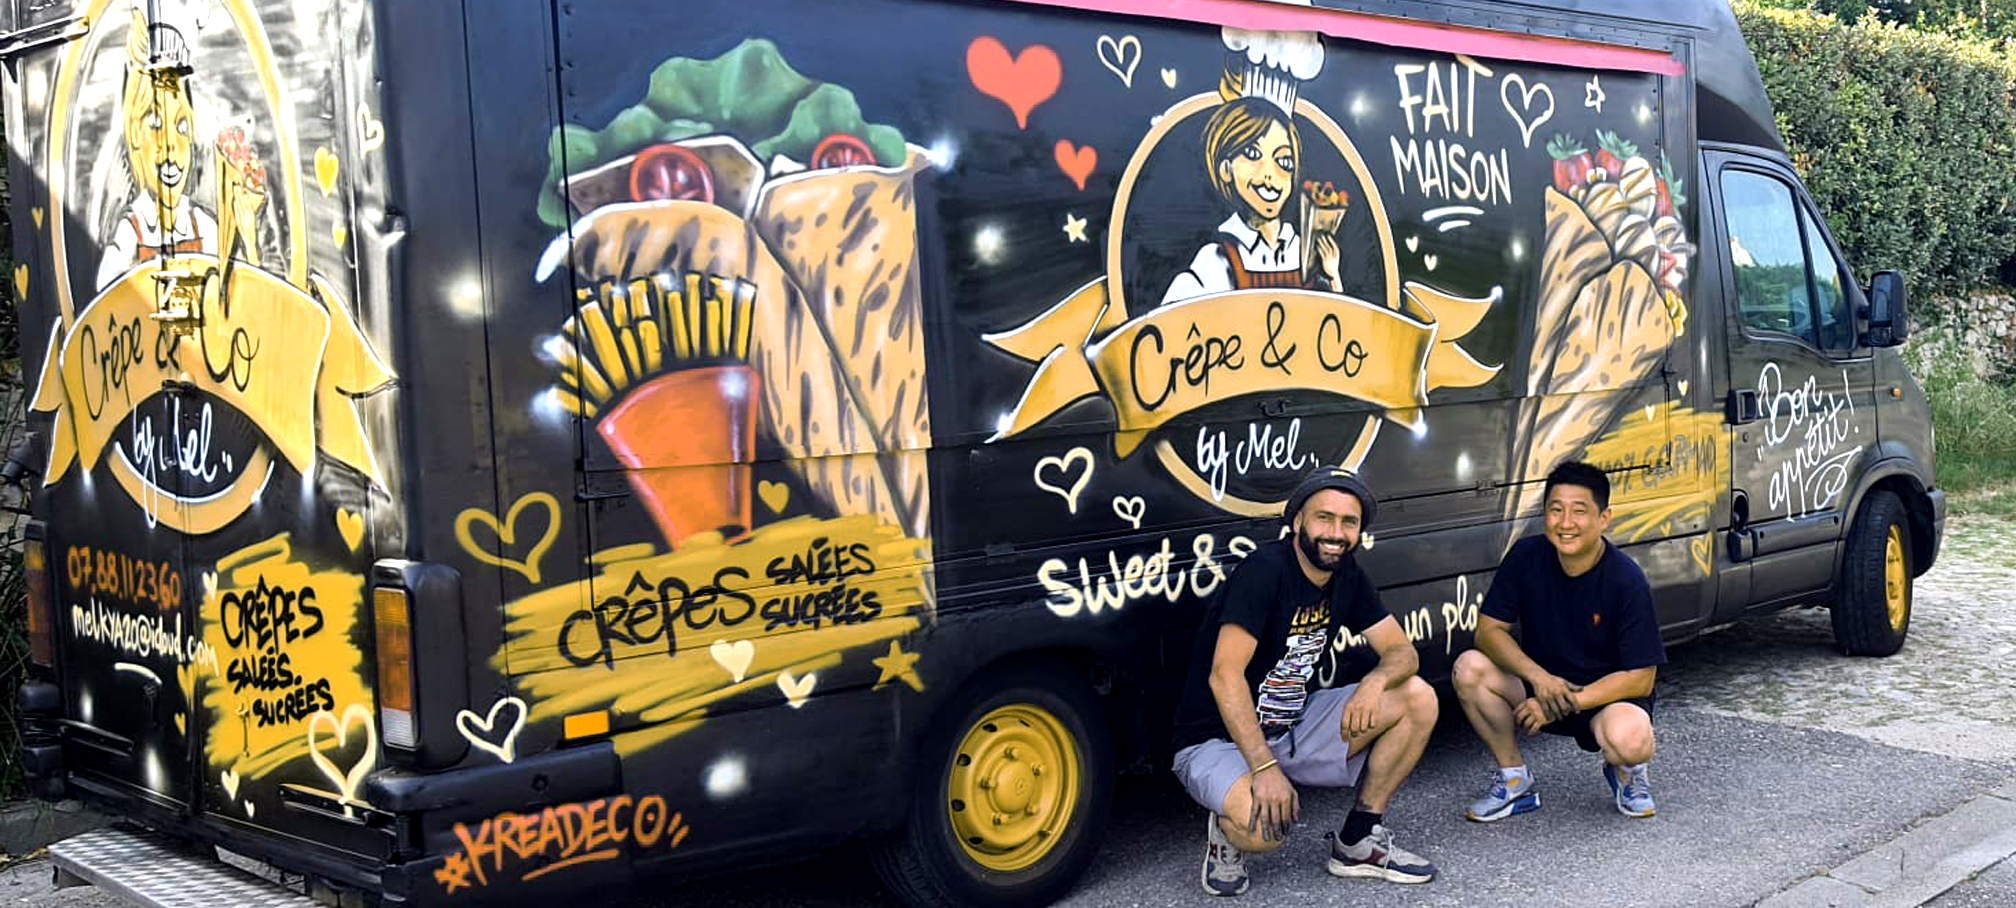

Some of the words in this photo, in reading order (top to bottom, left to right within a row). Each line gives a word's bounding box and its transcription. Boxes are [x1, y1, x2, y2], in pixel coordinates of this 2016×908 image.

[1393, 53, 1494, 138] FAIT
[1390, 134, 1512, 206] MAISON
[80, 313, 145, 421] Crêpe
[200, 266, 261, 392] Co
[1130, 323, 1245, 411] Crêpe
[1261, 301, 1297, 376] &
[1317, 313, 1368, 378] Co
[1758, 362, 1823, 446] Bon
[133, 402, 158, 529] by
[1196, 425, 1229, 501] by
[1235, 417, 1307, 475] Mel
[766, 536, 876, 585] SALÉES
[1190, 533, 1227, 598] &
[220, 574, 324, 654] CRÊPES
[1405, 606, 1433, 644] un
[453, 793, 667, 887] KREADECO
